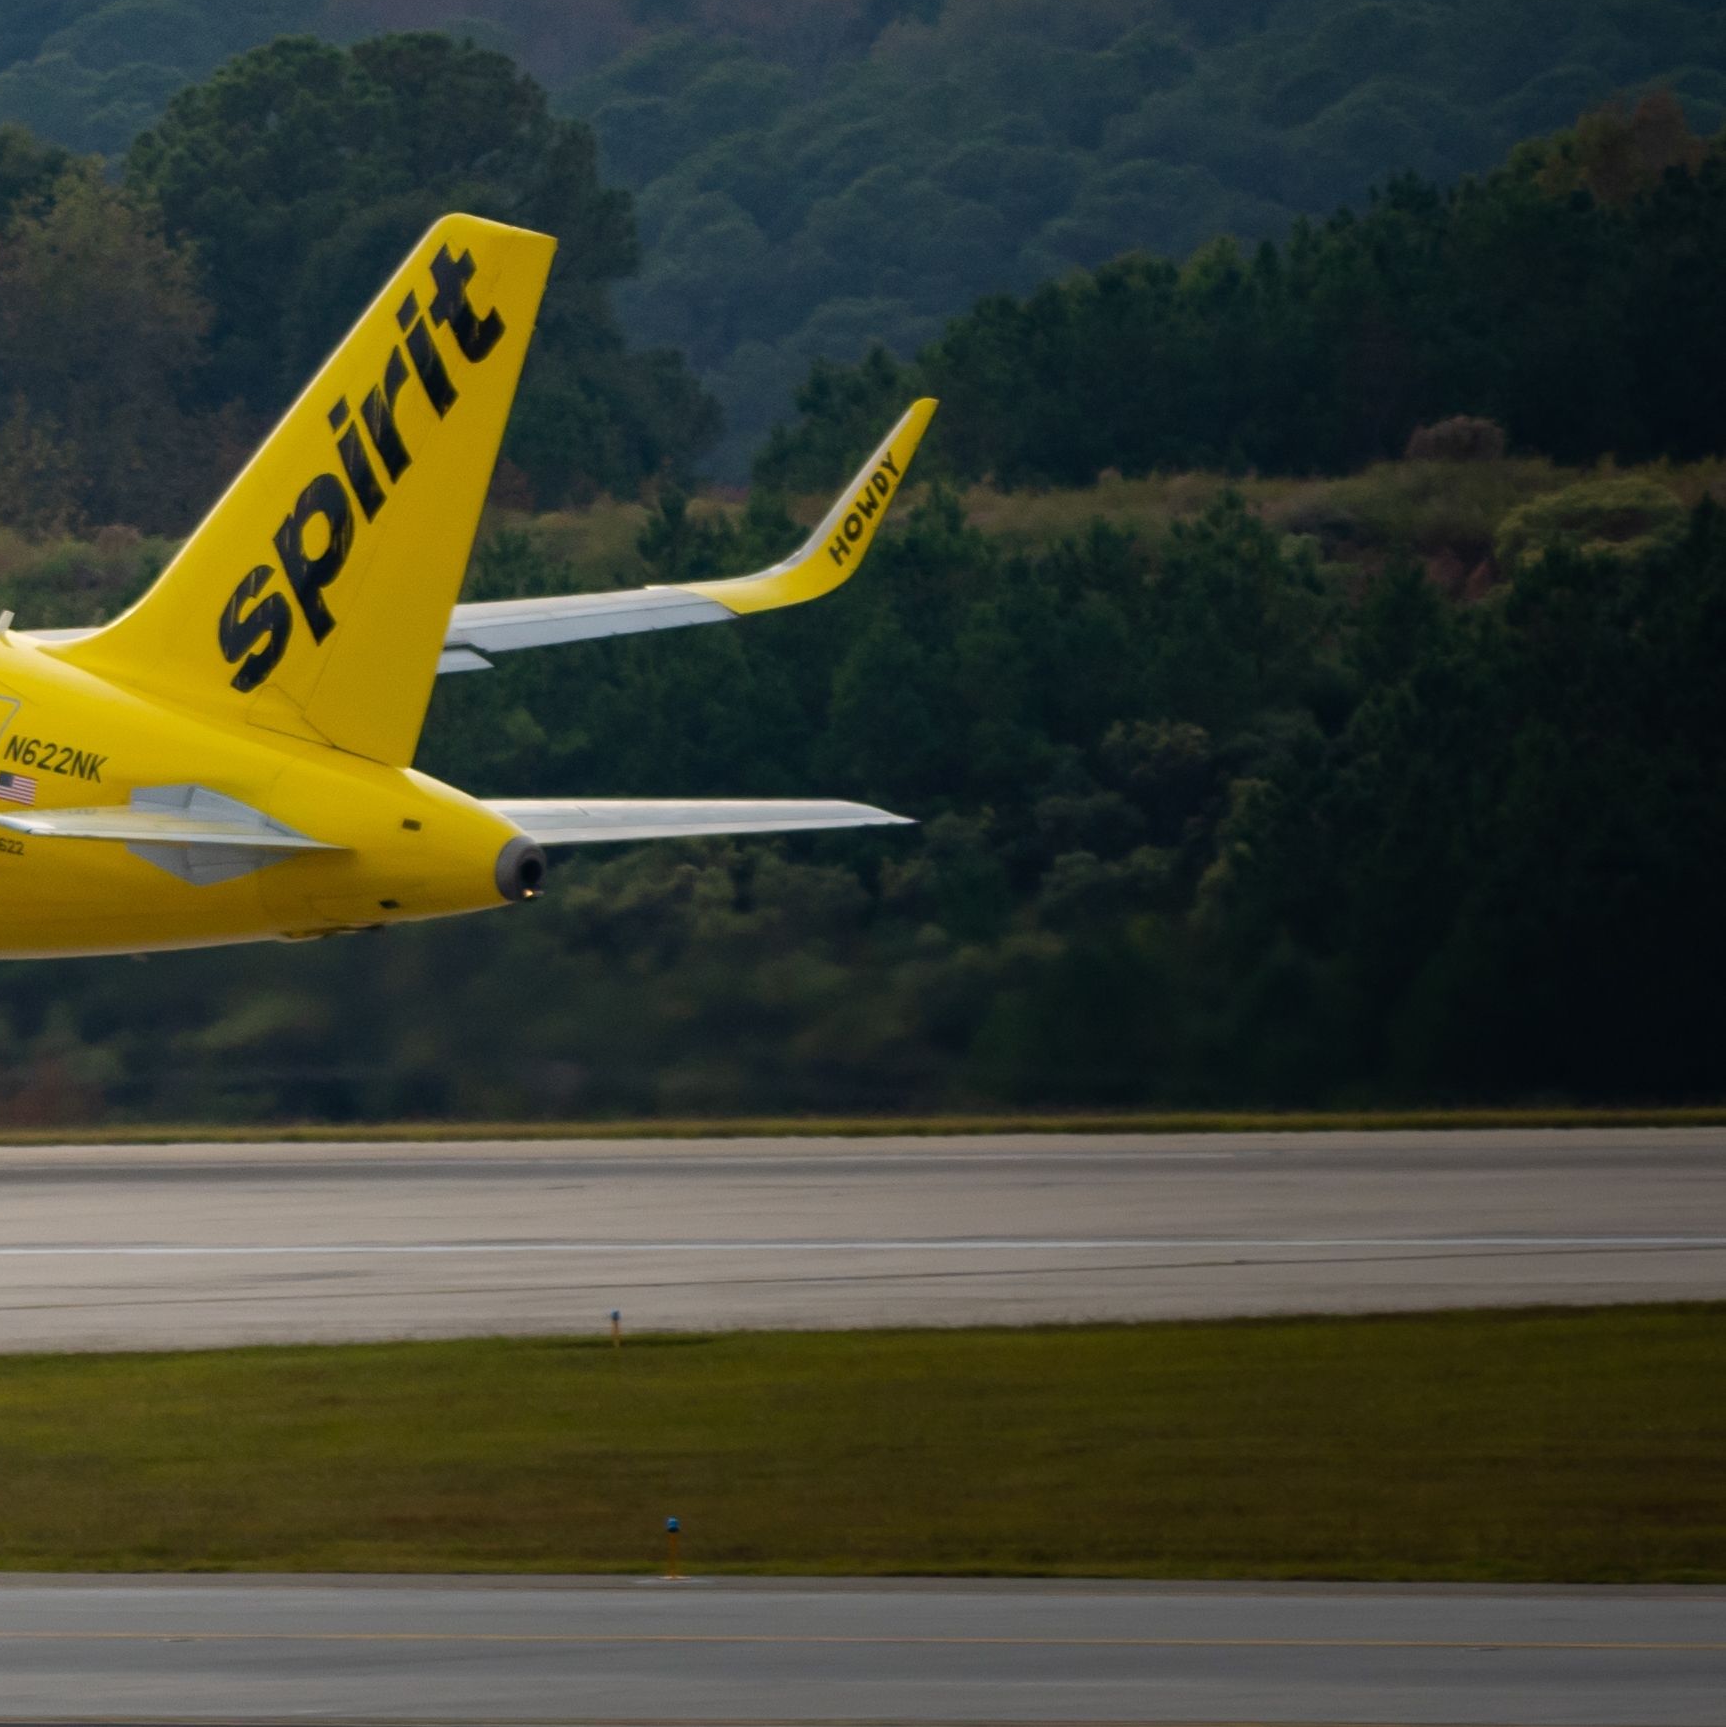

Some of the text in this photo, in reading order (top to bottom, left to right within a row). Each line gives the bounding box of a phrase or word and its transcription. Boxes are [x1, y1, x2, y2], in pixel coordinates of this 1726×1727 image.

[218, 243, 506, 693] spirit
[828, 451, 899, 566] HOWDY
[3, 734, 108, 782] N622NK
